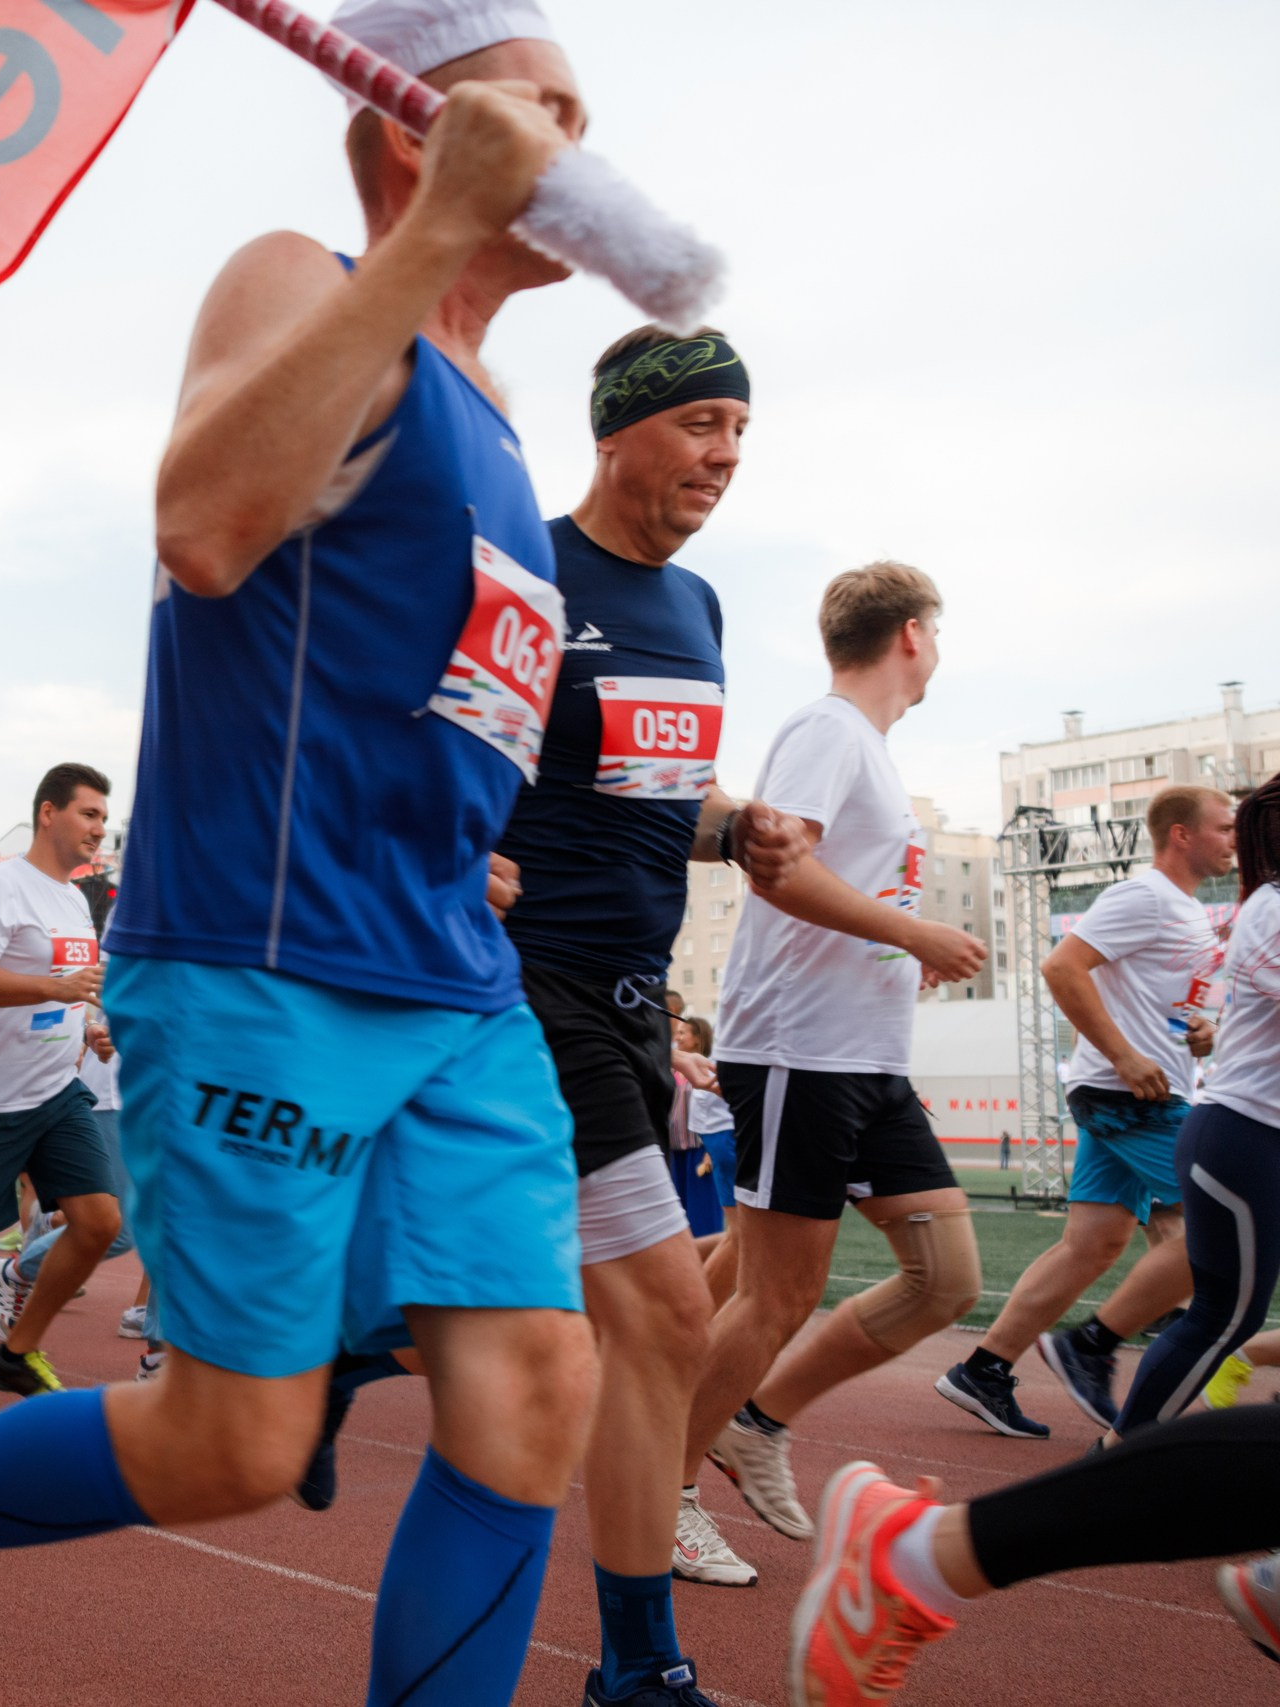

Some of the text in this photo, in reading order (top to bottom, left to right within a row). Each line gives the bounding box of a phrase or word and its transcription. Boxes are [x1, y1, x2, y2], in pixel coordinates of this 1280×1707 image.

[490, 605, 556, 700] 062
[632, 707, 700, 752] 059
[65, 941, 90, 962] 253
[949, 1098, 1018, 1111] МАНЕЖ
[668, 1667, 686, 1681] NIKE
